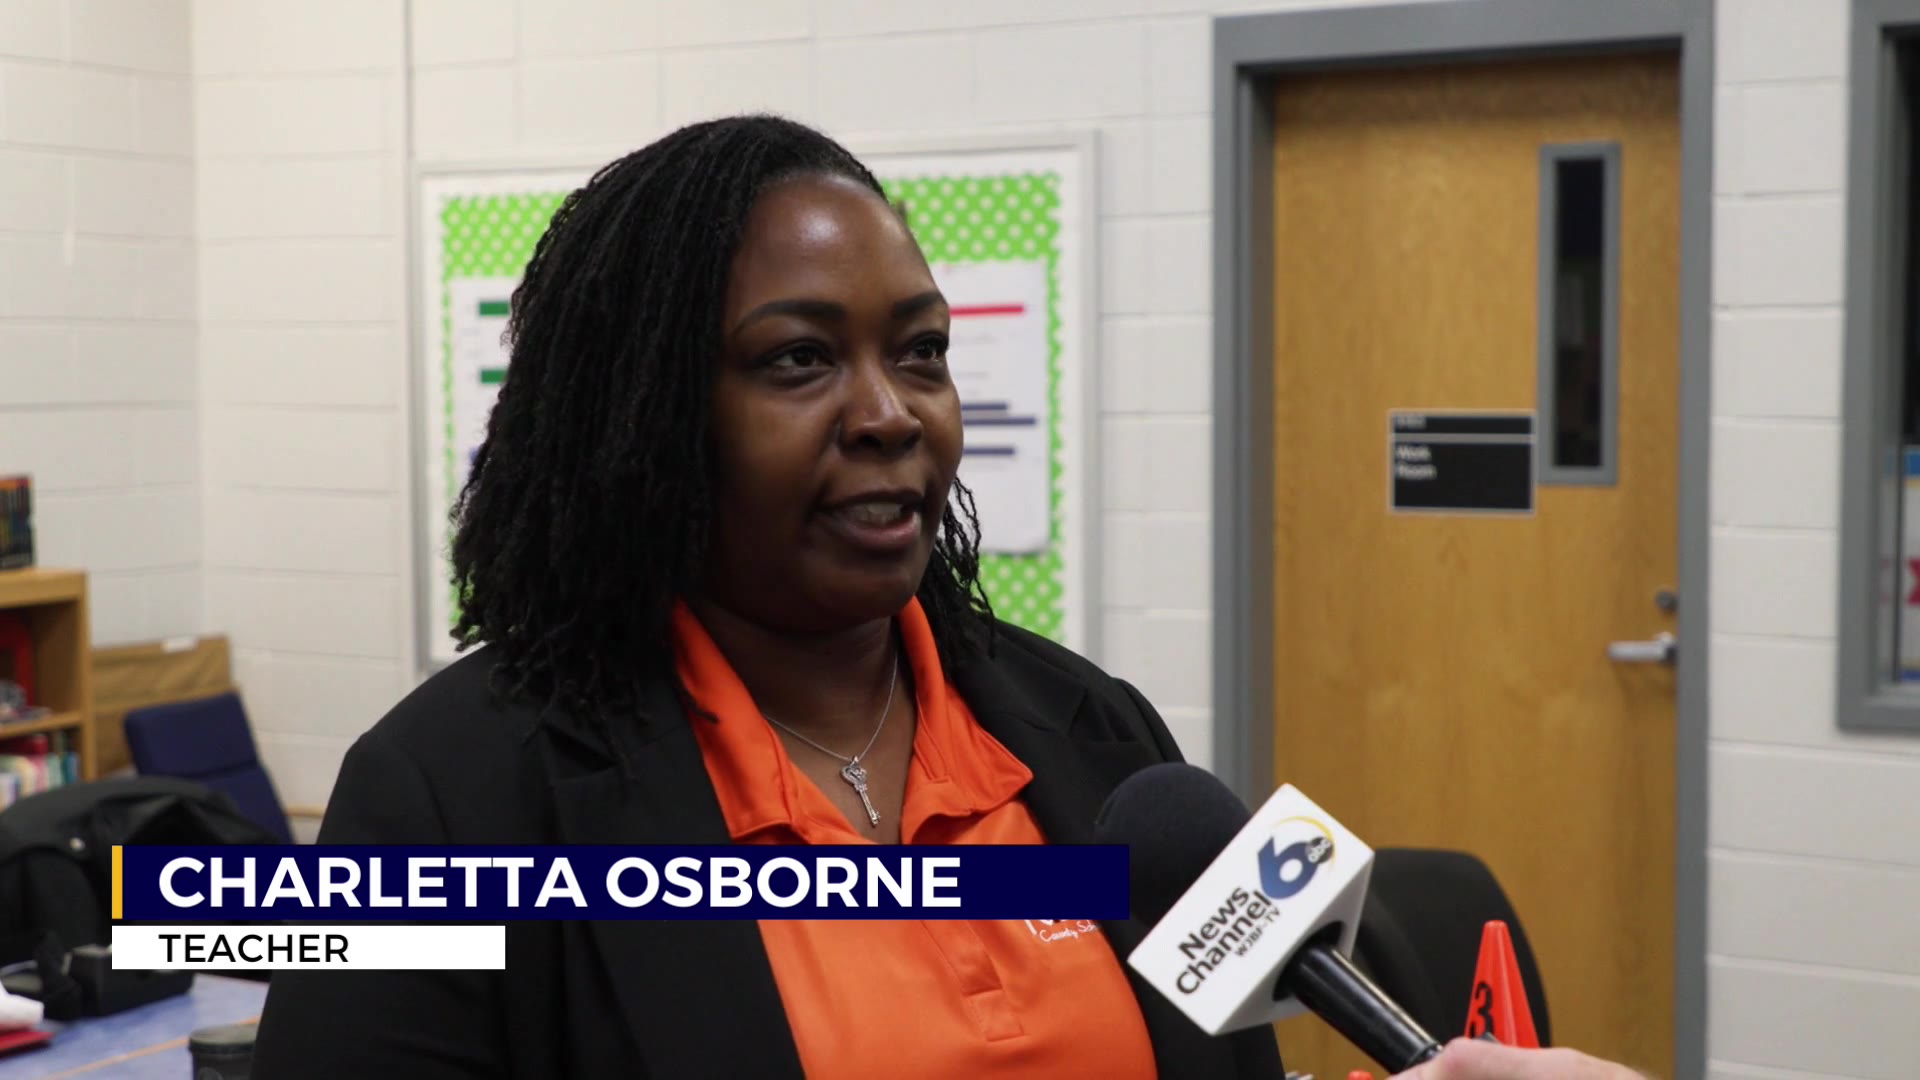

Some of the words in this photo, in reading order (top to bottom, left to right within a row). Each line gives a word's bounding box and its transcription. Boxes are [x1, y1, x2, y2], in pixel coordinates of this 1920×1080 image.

[1258, 836, 1321, 900] 6
[1308, 839, 1332, 864] abc
[1176, 890, 1272, 996] Channel
[1177, 887, 1250, 960] News
[1469, 980, 1495, 1039] 3
